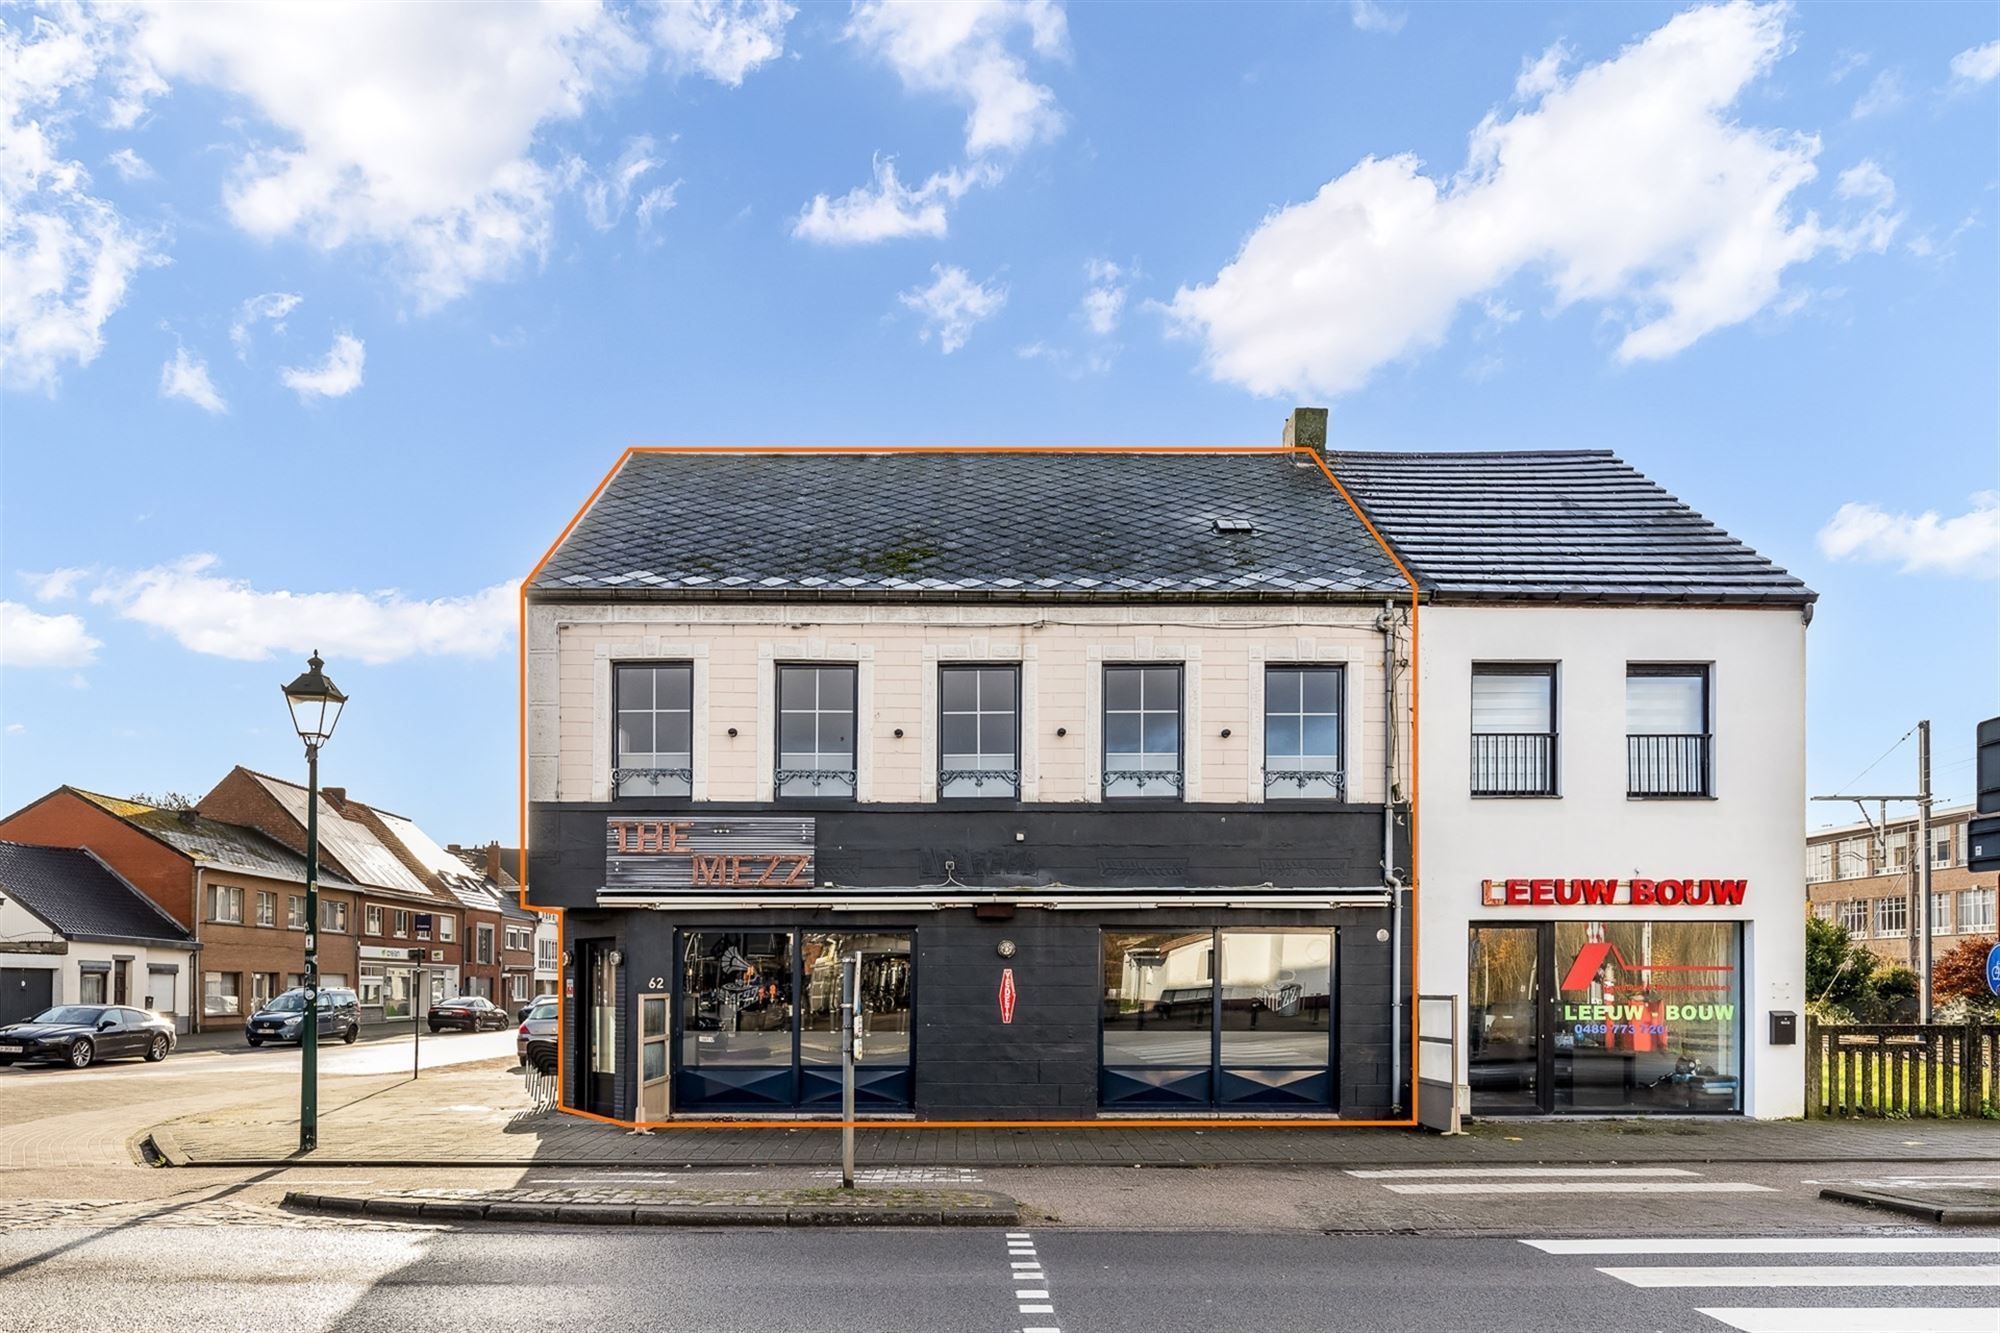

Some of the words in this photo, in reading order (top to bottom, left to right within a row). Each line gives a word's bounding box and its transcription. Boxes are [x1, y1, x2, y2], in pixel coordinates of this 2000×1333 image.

[608, 822, 694, 852] THE
[691, 854, 812, 885] MEZZ
[1481, 879, 1618, 906] LEEUW
[1630, 879, 1748, 906] BOUW
[648, 978, 664, 989] 62
[1263, 986, 1297, 1012] MEZZ
[1564, 1005, 1645, 1021] LEEUW
[1665, 1005, 1735, 1021] BOUW
[1574, 1024, 1607, 1034] 0489
[1612, 1024, 1636, 1034] 773
